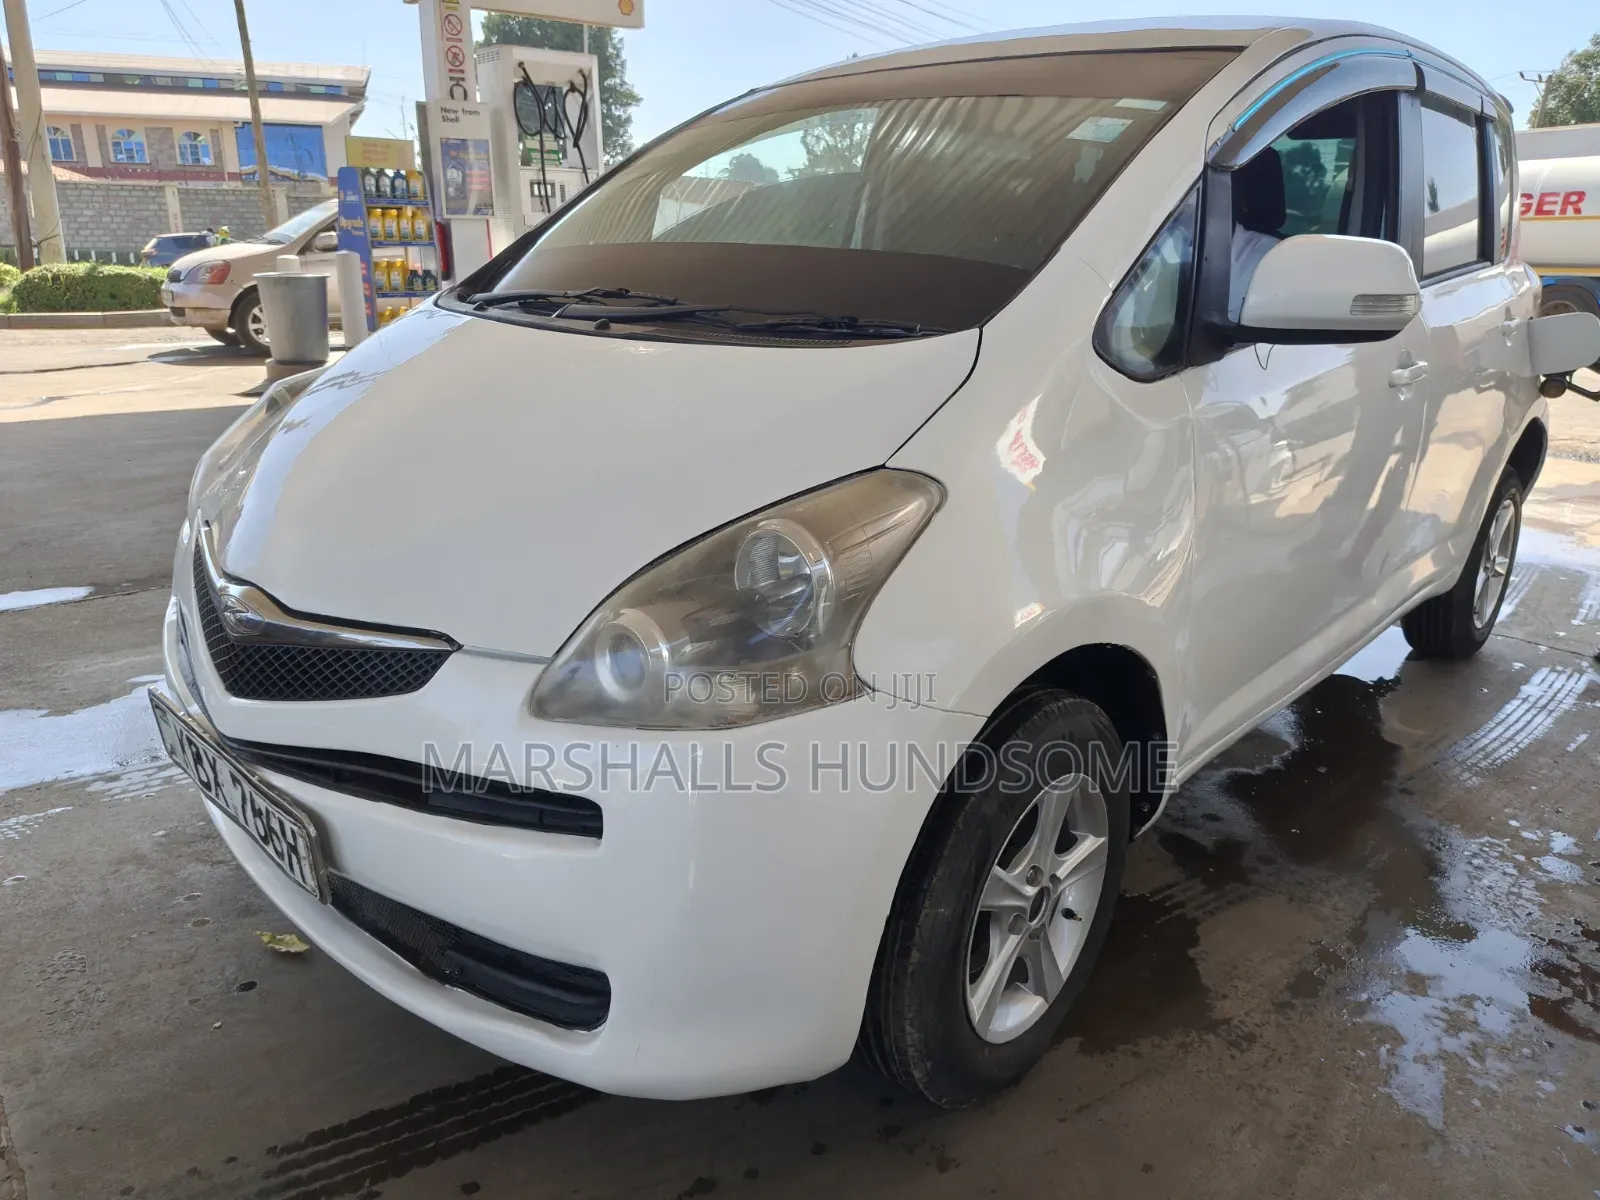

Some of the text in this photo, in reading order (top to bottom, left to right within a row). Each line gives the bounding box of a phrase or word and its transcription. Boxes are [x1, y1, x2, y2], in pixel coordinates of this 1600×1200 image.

[440, 106, 481, 117] New from
[441, 115, 460, 124] Shell
